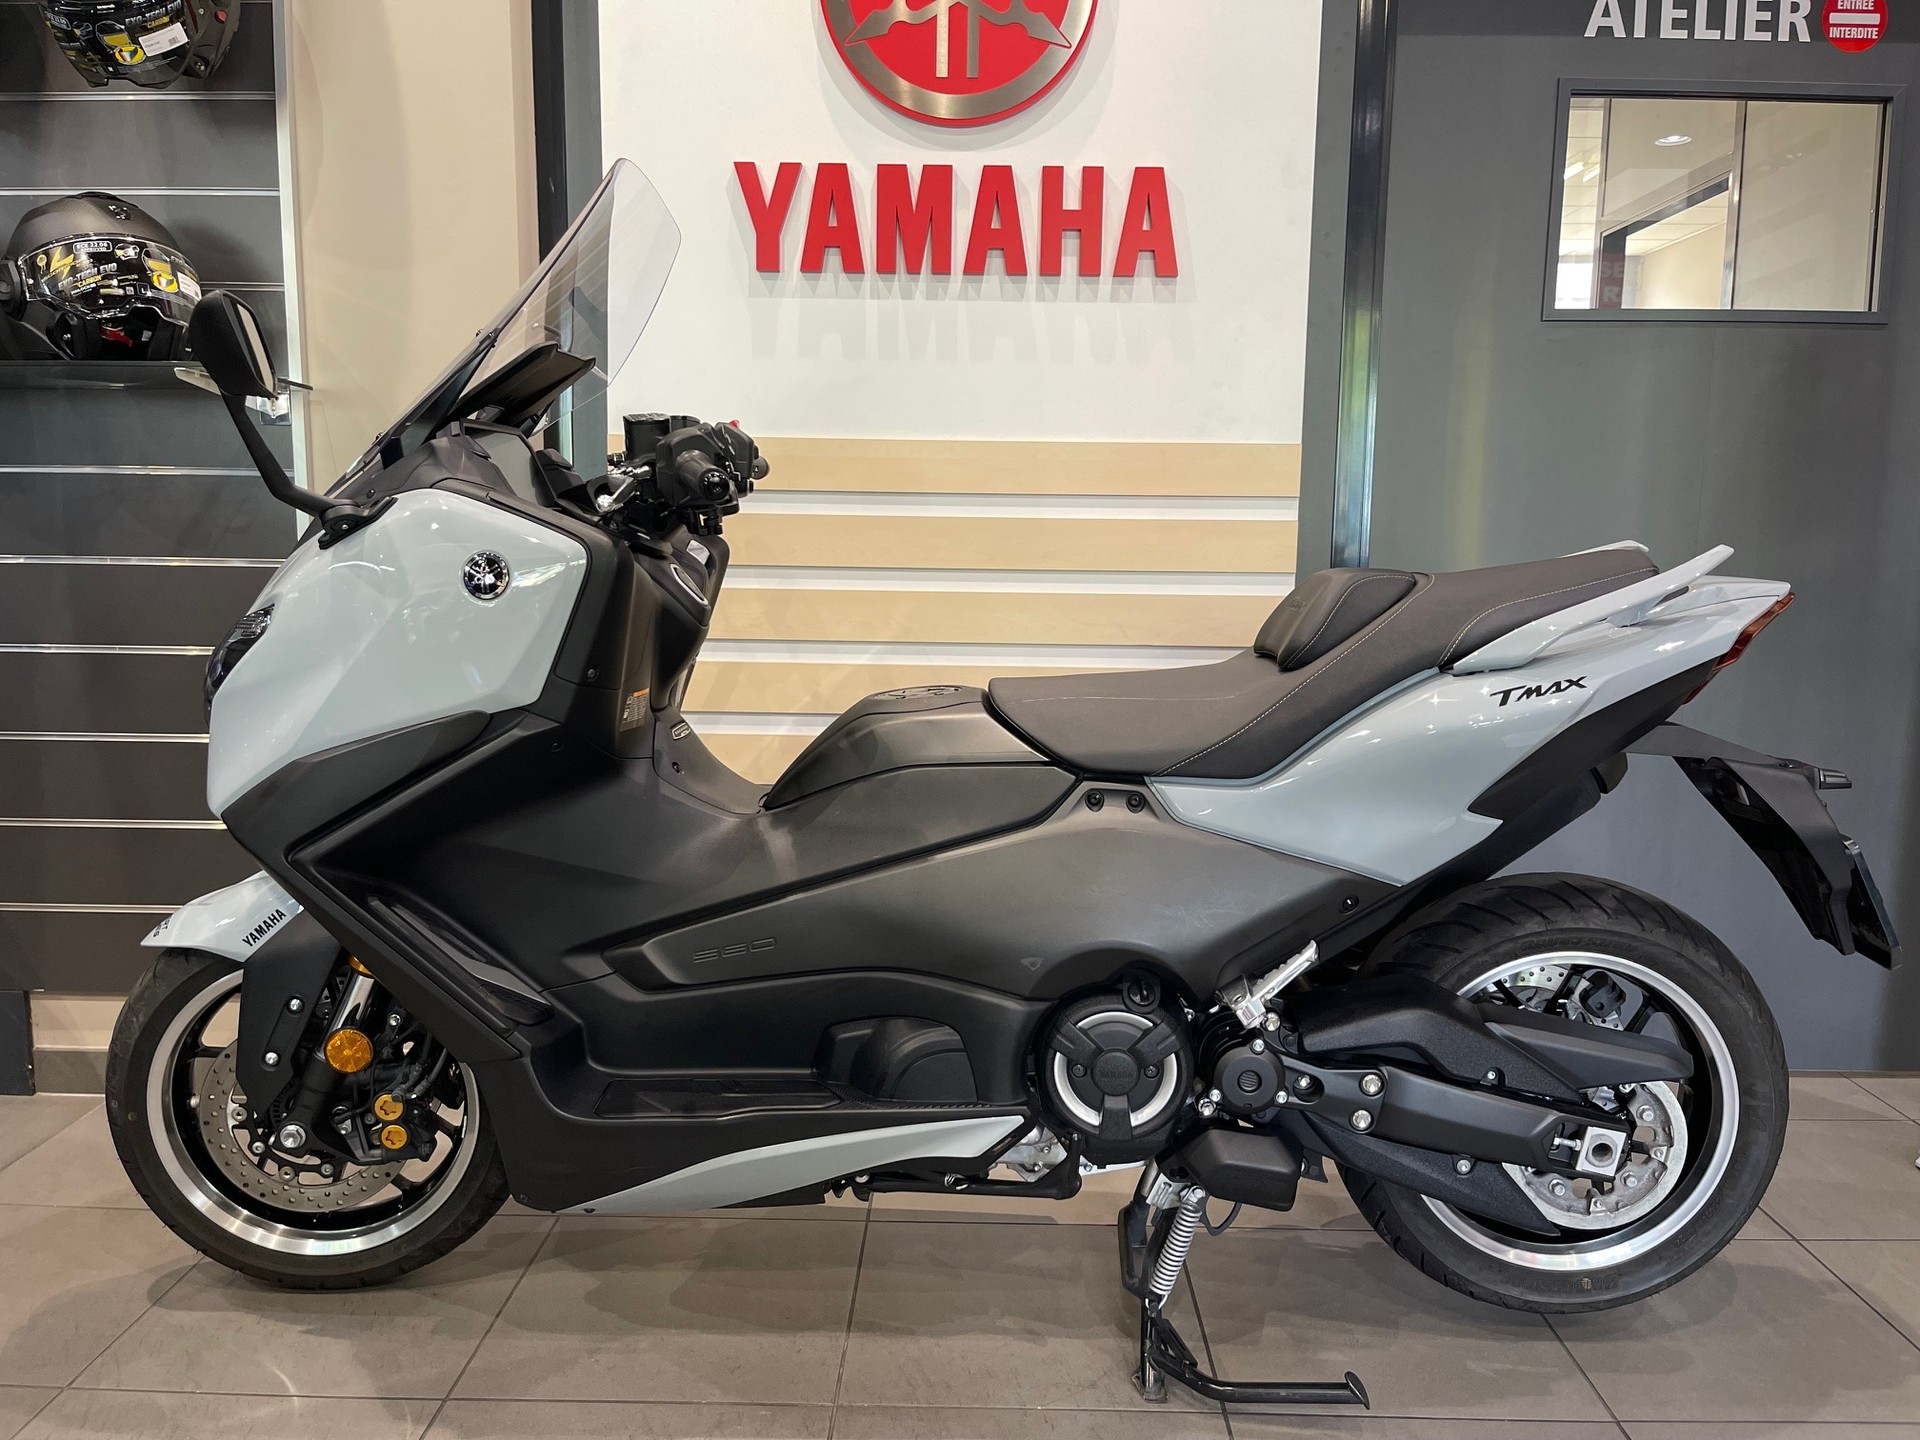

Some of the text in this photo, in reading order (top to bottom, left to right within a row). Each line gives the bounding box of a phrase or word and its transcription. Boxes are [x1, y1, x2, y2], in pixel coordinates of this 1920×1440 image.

[1583, 0, 1811, 42] ATELIER
[1829, 27, 1879, 39] INTERDITE
[733, 161, 1179, 278] YAMAHA
[99, 262, 118, 274] EVO
[1489, 675, 1589, 707] TMAX
[242, 908, 287, 948] YAMAHA
[692, 936, 777, 964] 560
